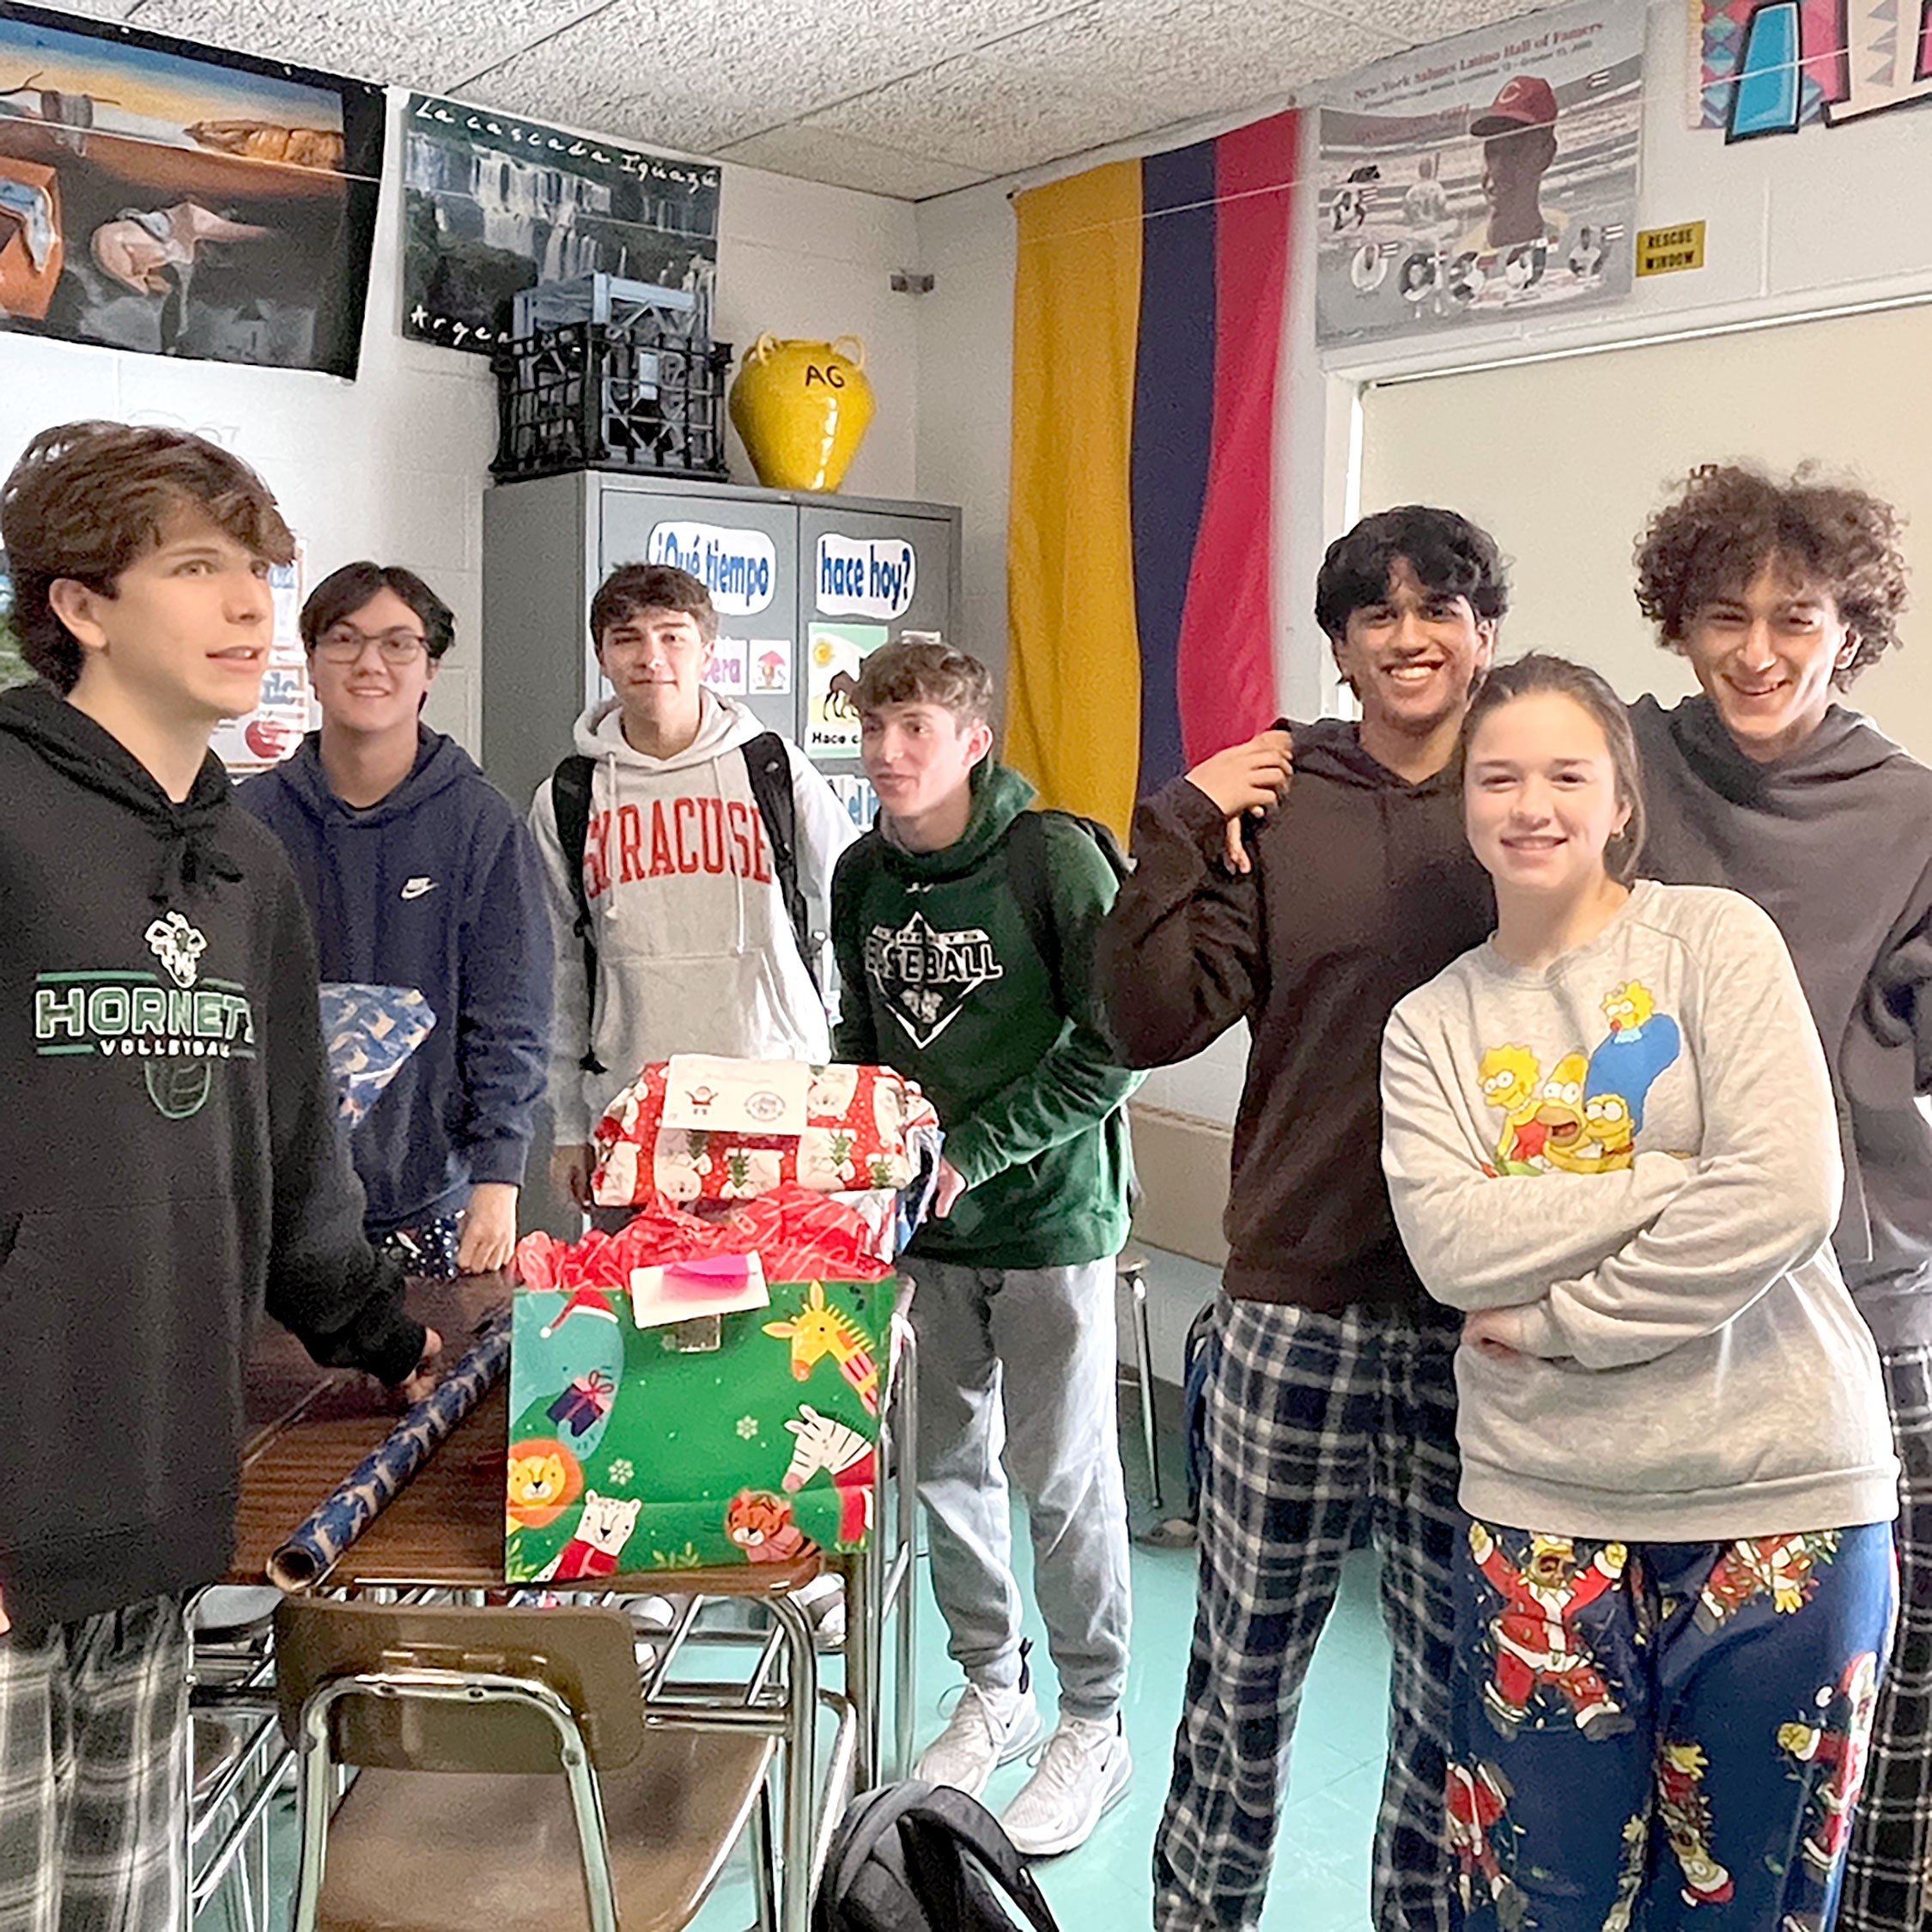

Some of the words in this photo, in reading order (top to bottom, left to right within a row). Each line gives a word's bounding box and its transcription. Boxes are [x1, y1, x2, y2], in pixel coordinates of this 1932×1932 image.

[1461, 52, 1500, 70] Latino
[1504, 39, 1531, 58] Hall
[1534, 34, 1549, 48] of
[1552, 22, 1603, 45] Famers
[416, 100, 454, 124] La
[467, 117, 611, 163] cascada
[1648, 228, 1693, 250] RESCUE
[1646, 251, 1694, 270] WINDOW
[410, 304, 515, 346] Argen
[805, 365, 844, 388] AG
[706, 541, 769, 607] tiempo
[821, 540, 864, 597] hace
[870, 544, 911, 611] hoy?
[812, 732, 847, 744] Hace
[583, 797, 772, 899] SYRACUSE
[100, 1038, 231, 1059] VOLLEYBAL
